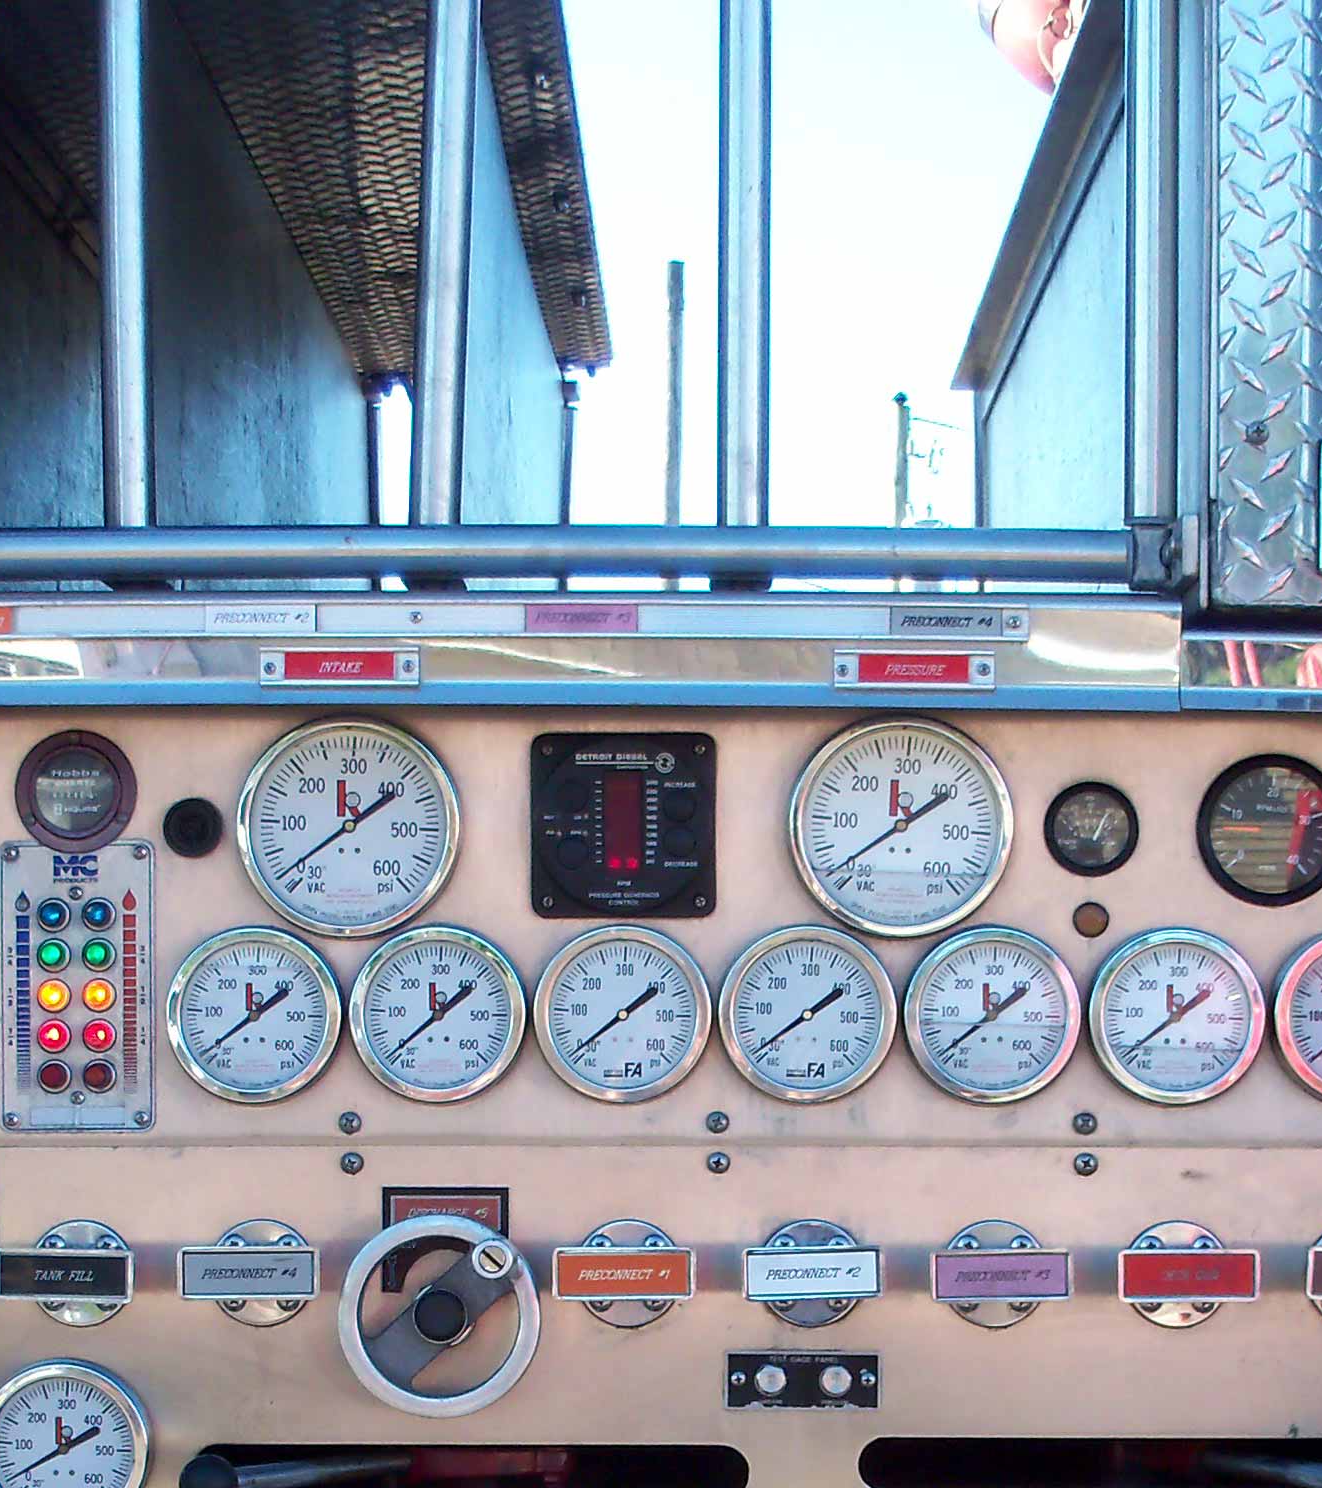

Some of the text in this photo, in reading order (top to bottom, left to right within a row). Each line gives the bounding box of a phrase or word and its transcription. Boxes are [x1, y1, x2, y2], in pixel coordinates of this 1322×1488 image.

[213, 612, 310, 624] PRECONNECT #2
[534, 611, 611, 624] PRECONNECT
[901, 616, 993, 628] PRECONNECT #4
[318, 661, 363, 674] INTAKE
[884, 664, 945, 677] PRESSURE
[340, 758, 367, 774] 300
[894, 758, 921, 774] 300
[299, 778, 325, 793] 200
[852, 776, 879, 792] 200
[282, 815, 306, 831] 100
[833, 812, 858, 828] 100
[391, 823, 418, 838] 500
[943, 825, 969, 840] 500
[53, 855, 98, 876] MC
[373, 860, 400, 876] 600
[923, 861, 951, 875] 600
[307, 882, 325, 893] VAC
[378, 881, 394, 896] psi
[856, 881, 875, 892] VAC
[927, 881, 943, 896] psi
[615, 963, 634, 976] 300
[984, 965, 1004, 976] 300
[582, 978, 602, 991] 200
[954, 979, 974, 990] 200
[570, 1003, 588, 1016] 100
[655, 1010, 674, 1022] 500
[941, 1006, 960, 1017] 100
[1023, 1011, 1043, 1023] 500
[646, 1038, 665, 1051] 600
[1012, 1039, 1032, 1051] 600
[34, 1270, 94, 1281] TANK FILL
[201, 1267, 298, 1280] PRECONNECT #4
[578, 1269, 671, 1281] PRECONNECT #1
[765, 1267, 862, 1280] PRECONNECT #2
[955, 1269, 1052, 1283] PRECONNECT #3
[57, 1399, 77, 1411] 300
[27, 1412, 47, 1424] 200
[15, 1439, 33, 1450] 100
[95, 1445, 115, 1457] 500
[84, 1473, 104, 1485] 600
